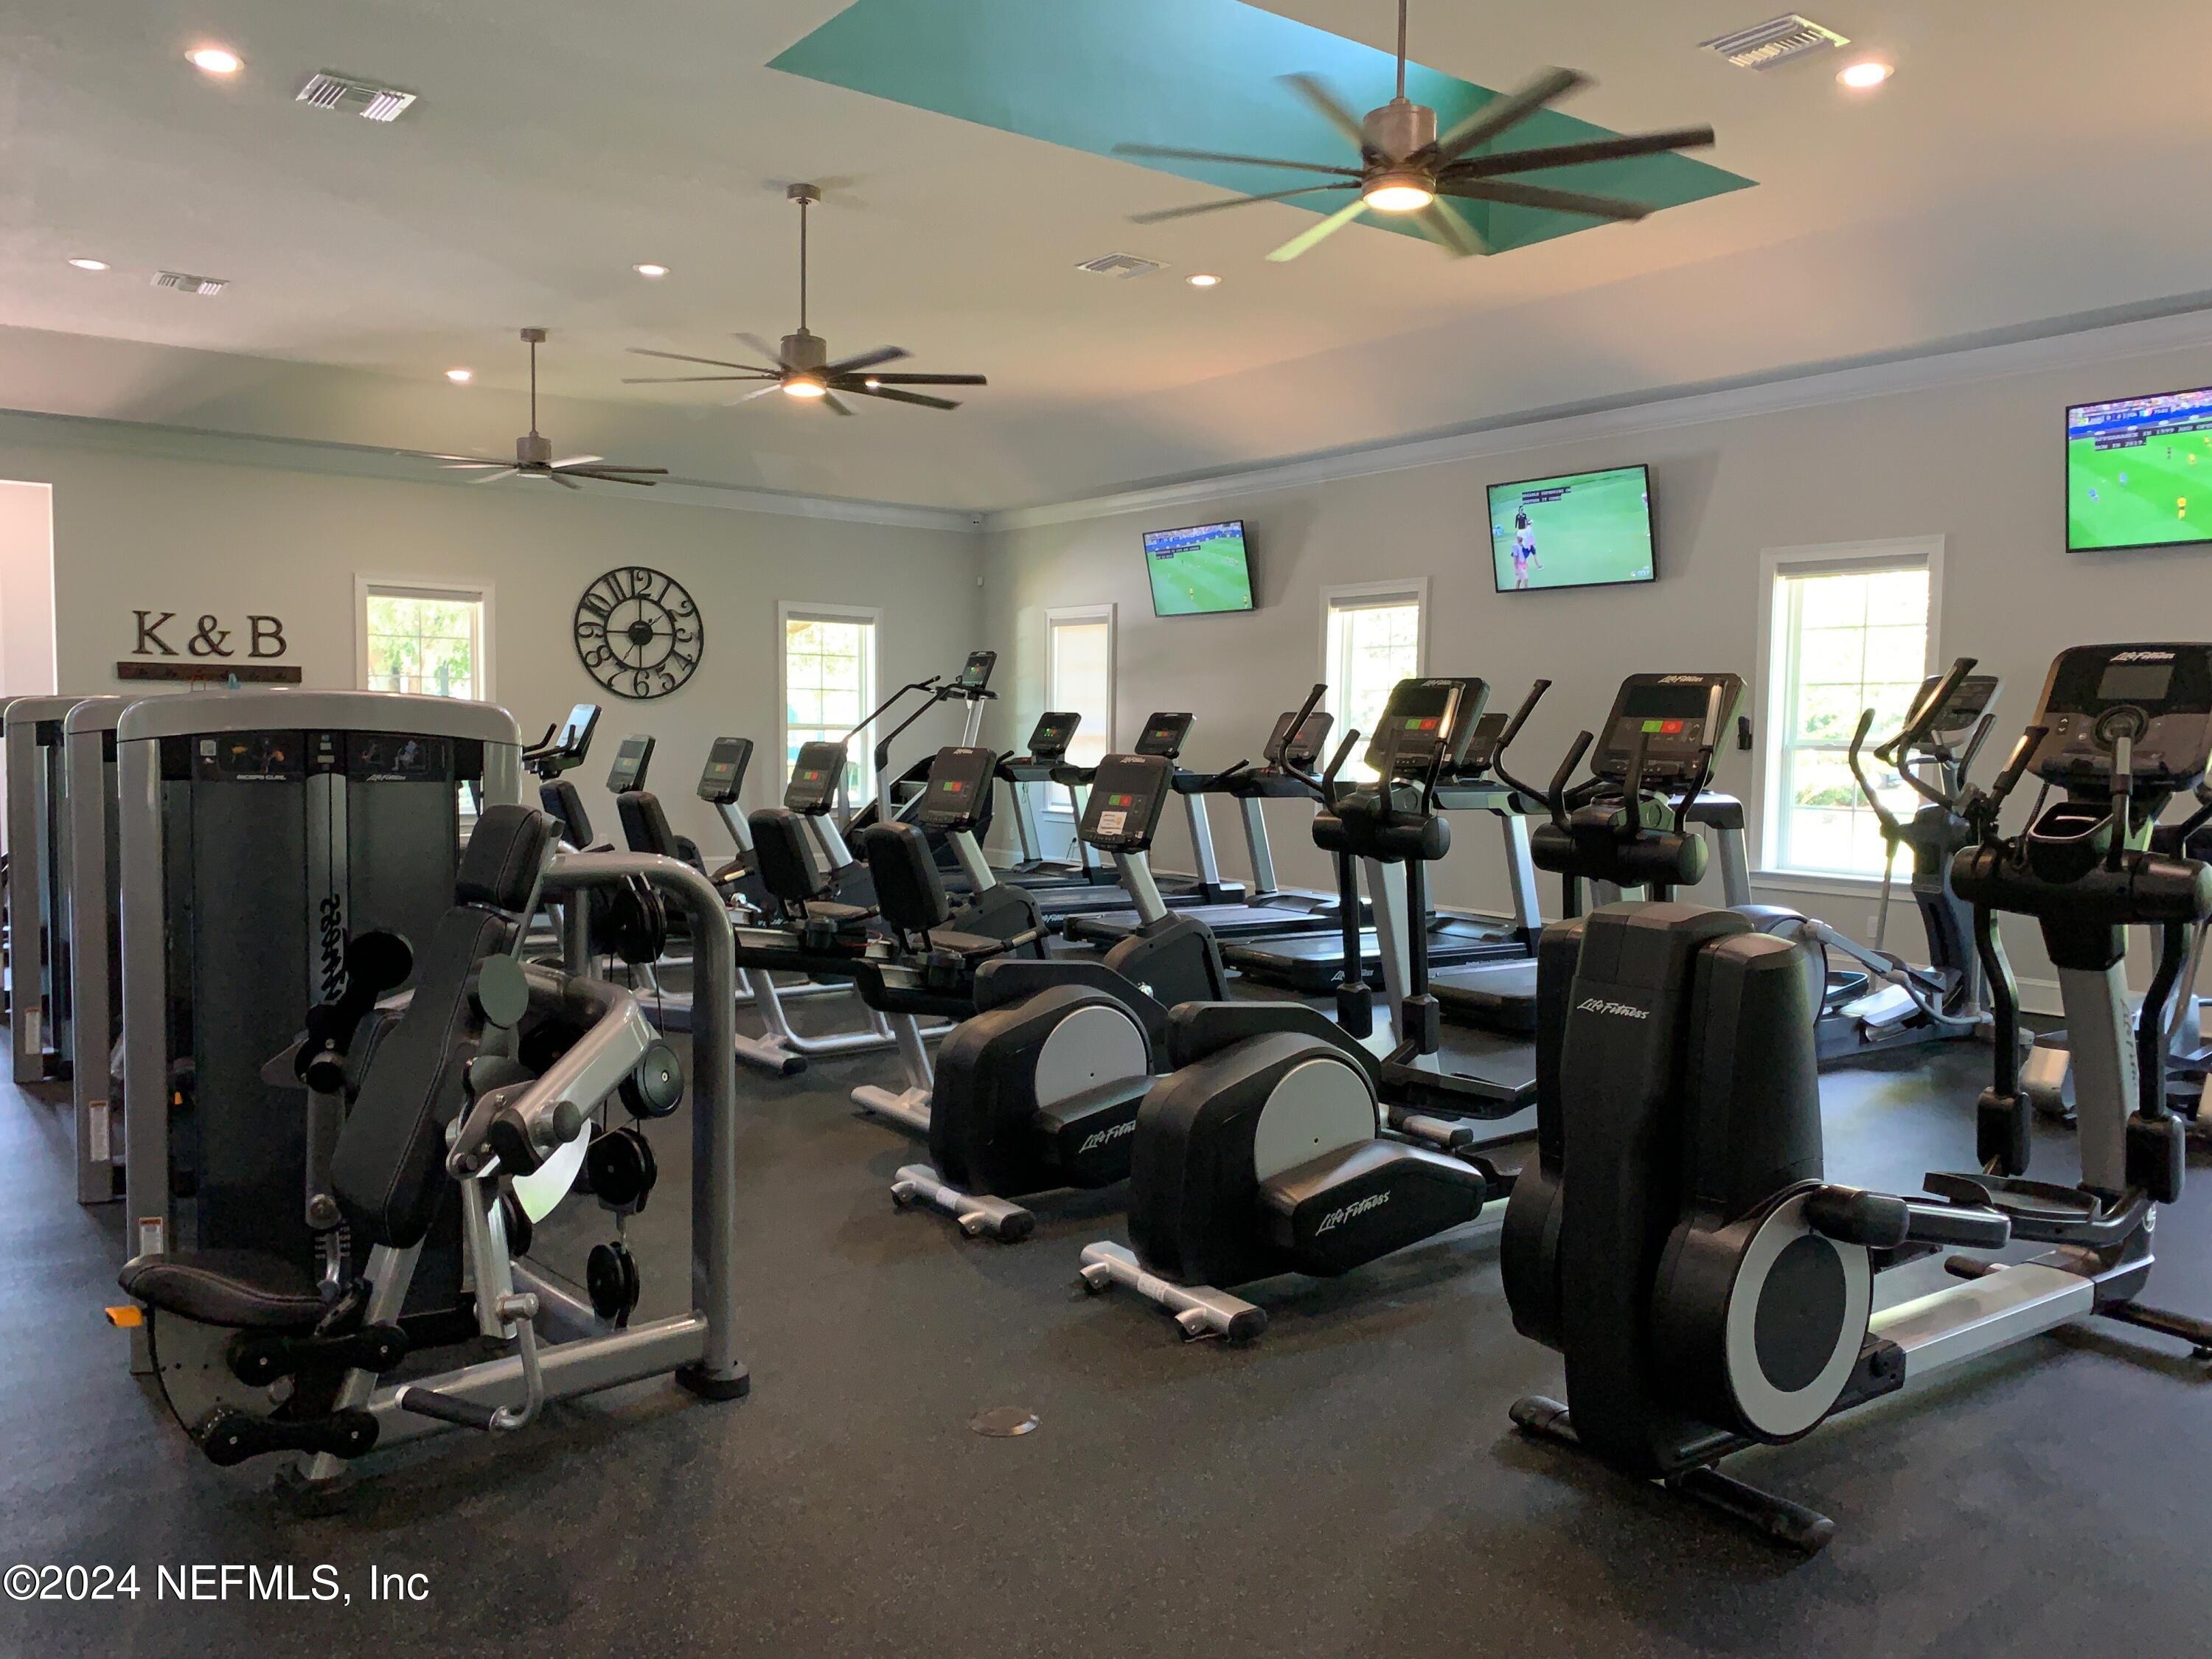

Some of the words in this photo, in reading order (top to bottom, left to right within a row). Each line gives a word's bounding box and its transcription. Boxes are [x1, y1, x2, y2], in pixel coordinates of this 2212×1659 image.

[630, 569, 652, 597] 12
[657, 580, 674, 605] 1
[581, 593, 613, 618] 10
[667, 600, 695, 622] 2
[133, 611, 179, 655] K
[189, 615, 234, 657] &
[247, 616, 287, 658] B
[577, 622, 605, 639] 9
[675, 627, 700, 642] 3
[585, 644, 613, 668] 8
[672, 648, 696, 671] 4
[607, 662, 628, 687] 7
[633, 669, 650, 697] 6
[655, 663, 675, 691] 5
